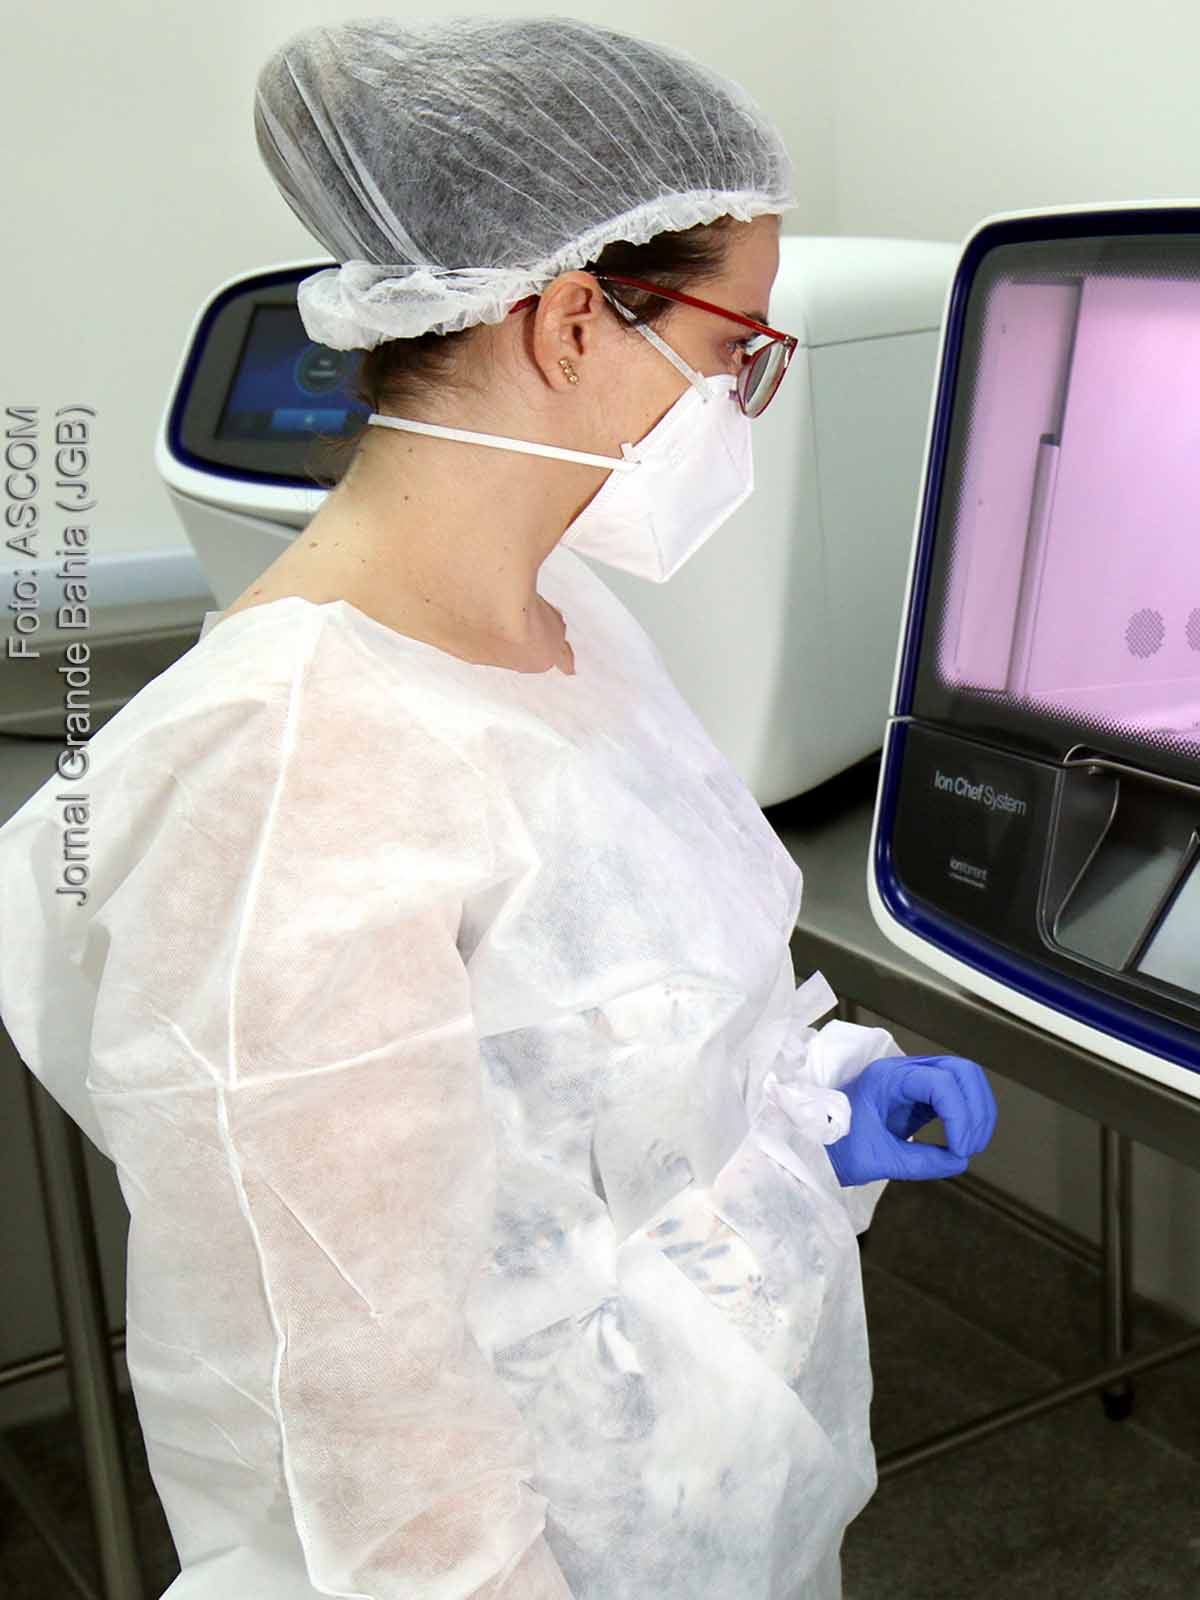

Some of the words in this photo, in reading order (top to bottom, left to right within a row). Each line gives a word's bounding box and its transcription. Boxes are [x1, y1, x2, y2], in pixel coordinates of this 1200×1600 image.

[934, 769, 954, 793] Ion
[954, 776, 985, 802] Chef
[983, 785, 1027, 816] System
